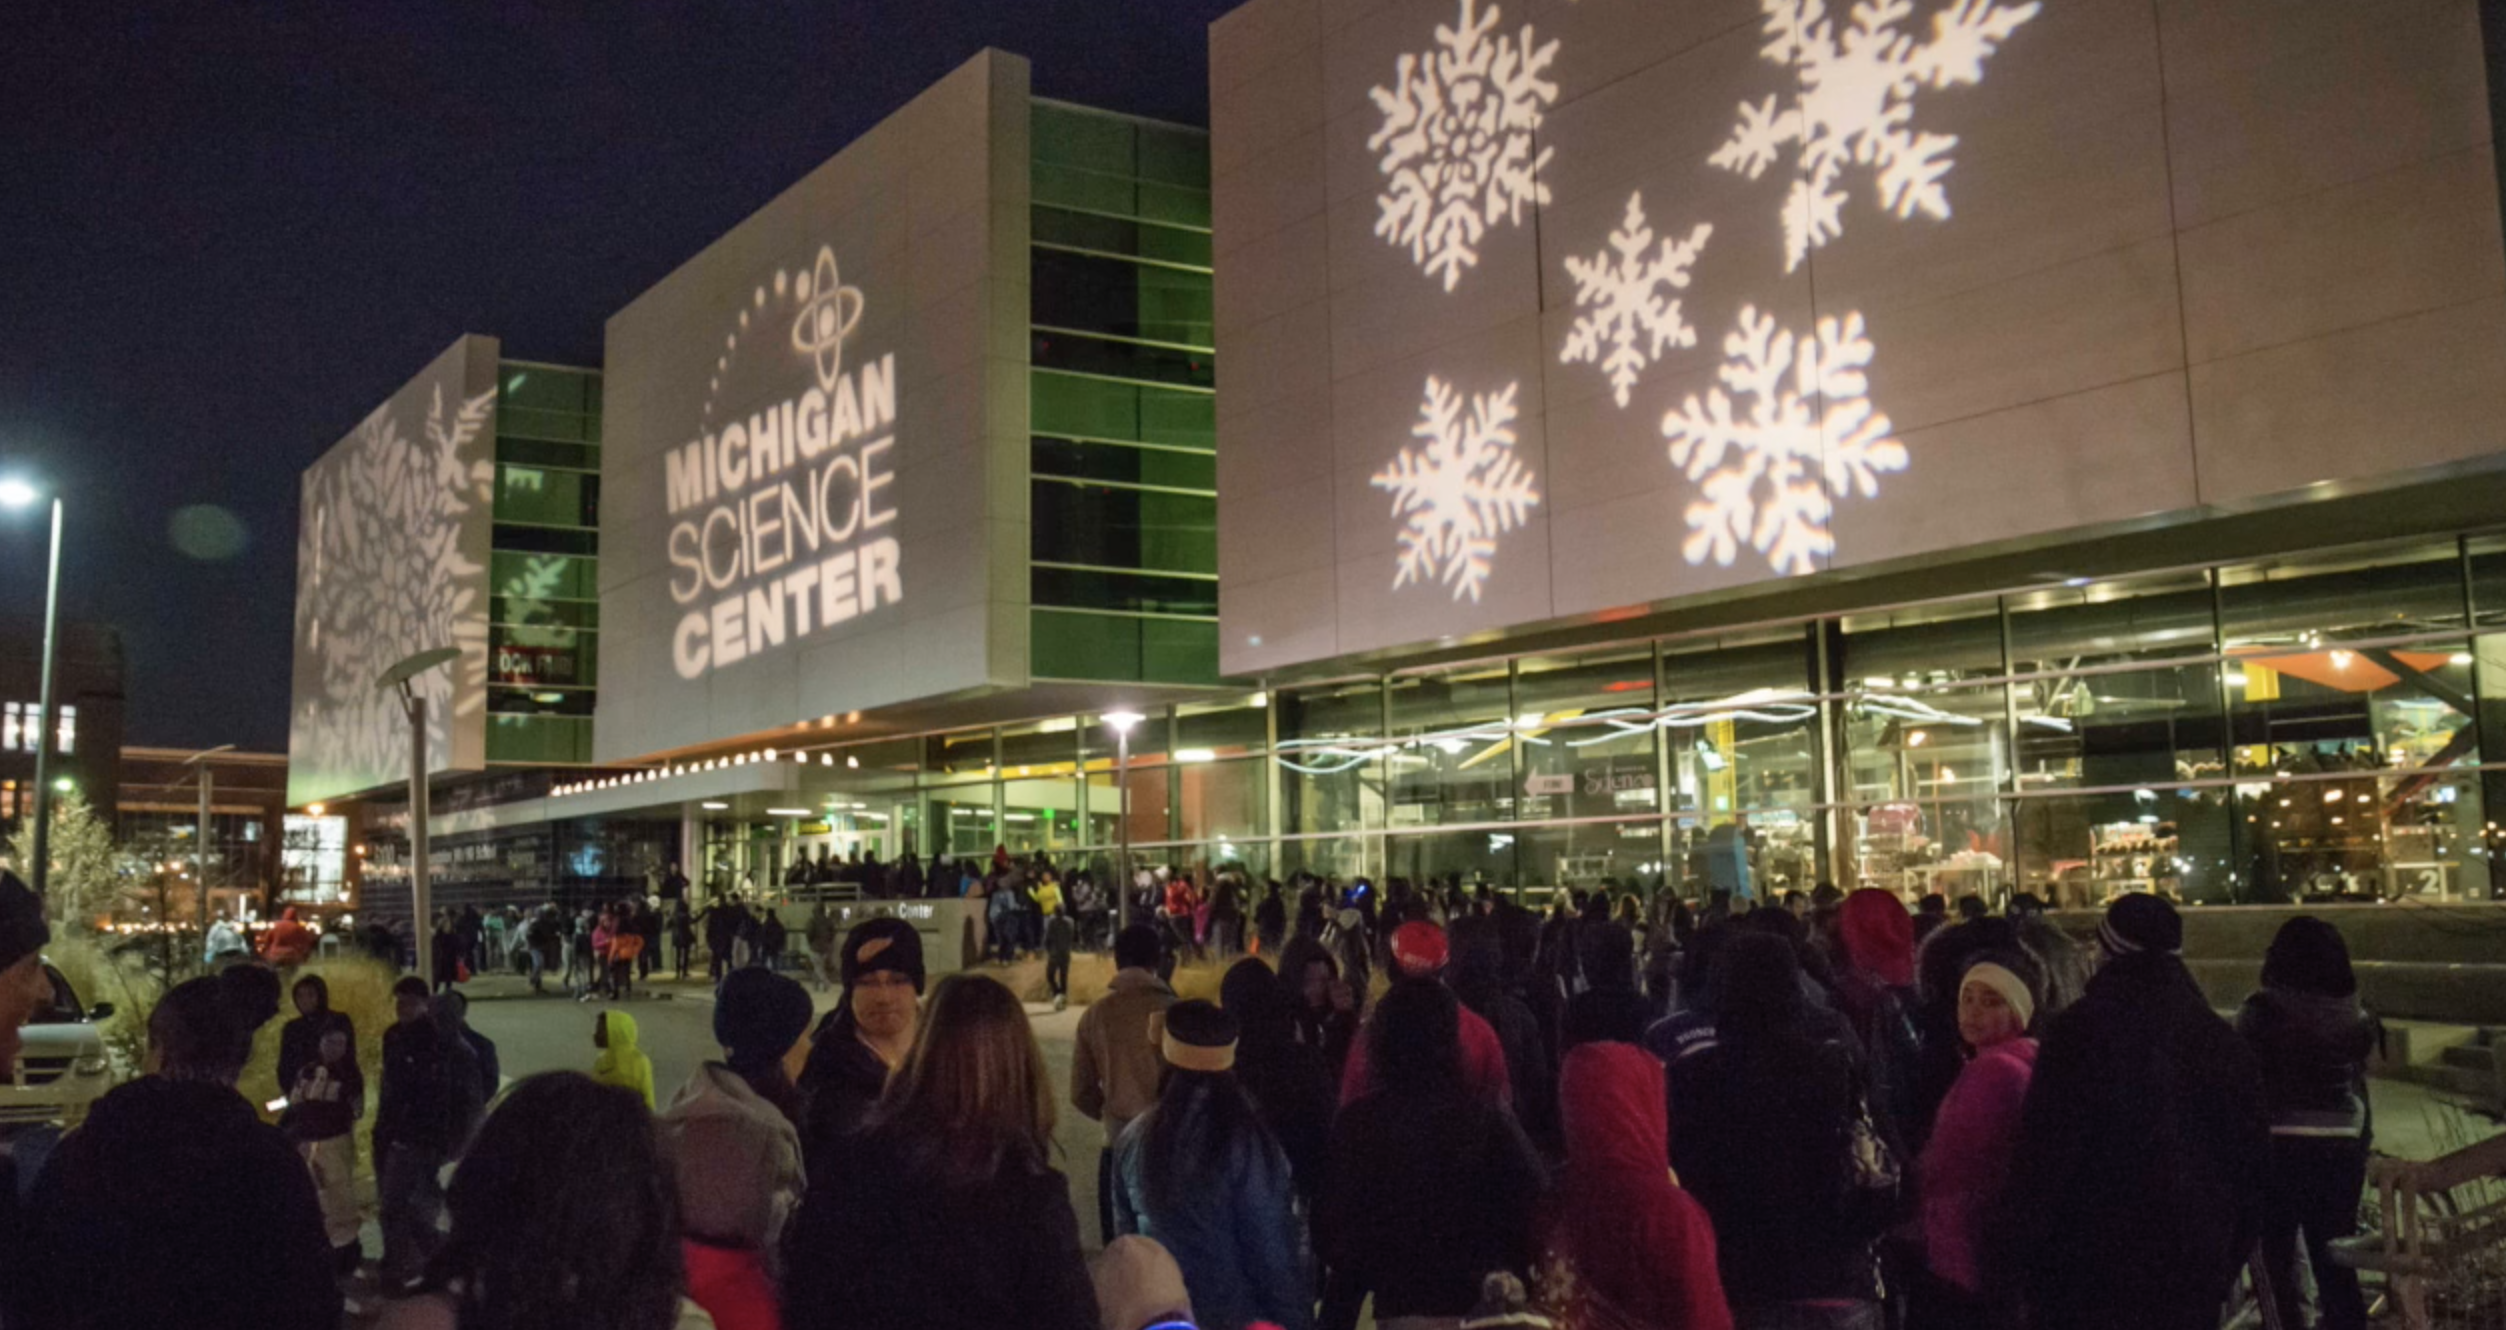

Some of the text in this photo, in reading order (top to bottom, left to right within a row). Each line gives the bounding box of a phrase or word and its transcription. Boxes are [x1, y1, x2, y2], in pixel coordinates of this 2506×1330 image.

[664, 352, 896, 514] MICHIGAN
[668, 435, 898, 604] SCIENCE
[672, 536, 902, 679] CENTER
[898, 902, 934, 919] Center
[2419, 869, 2439, 893] 2
